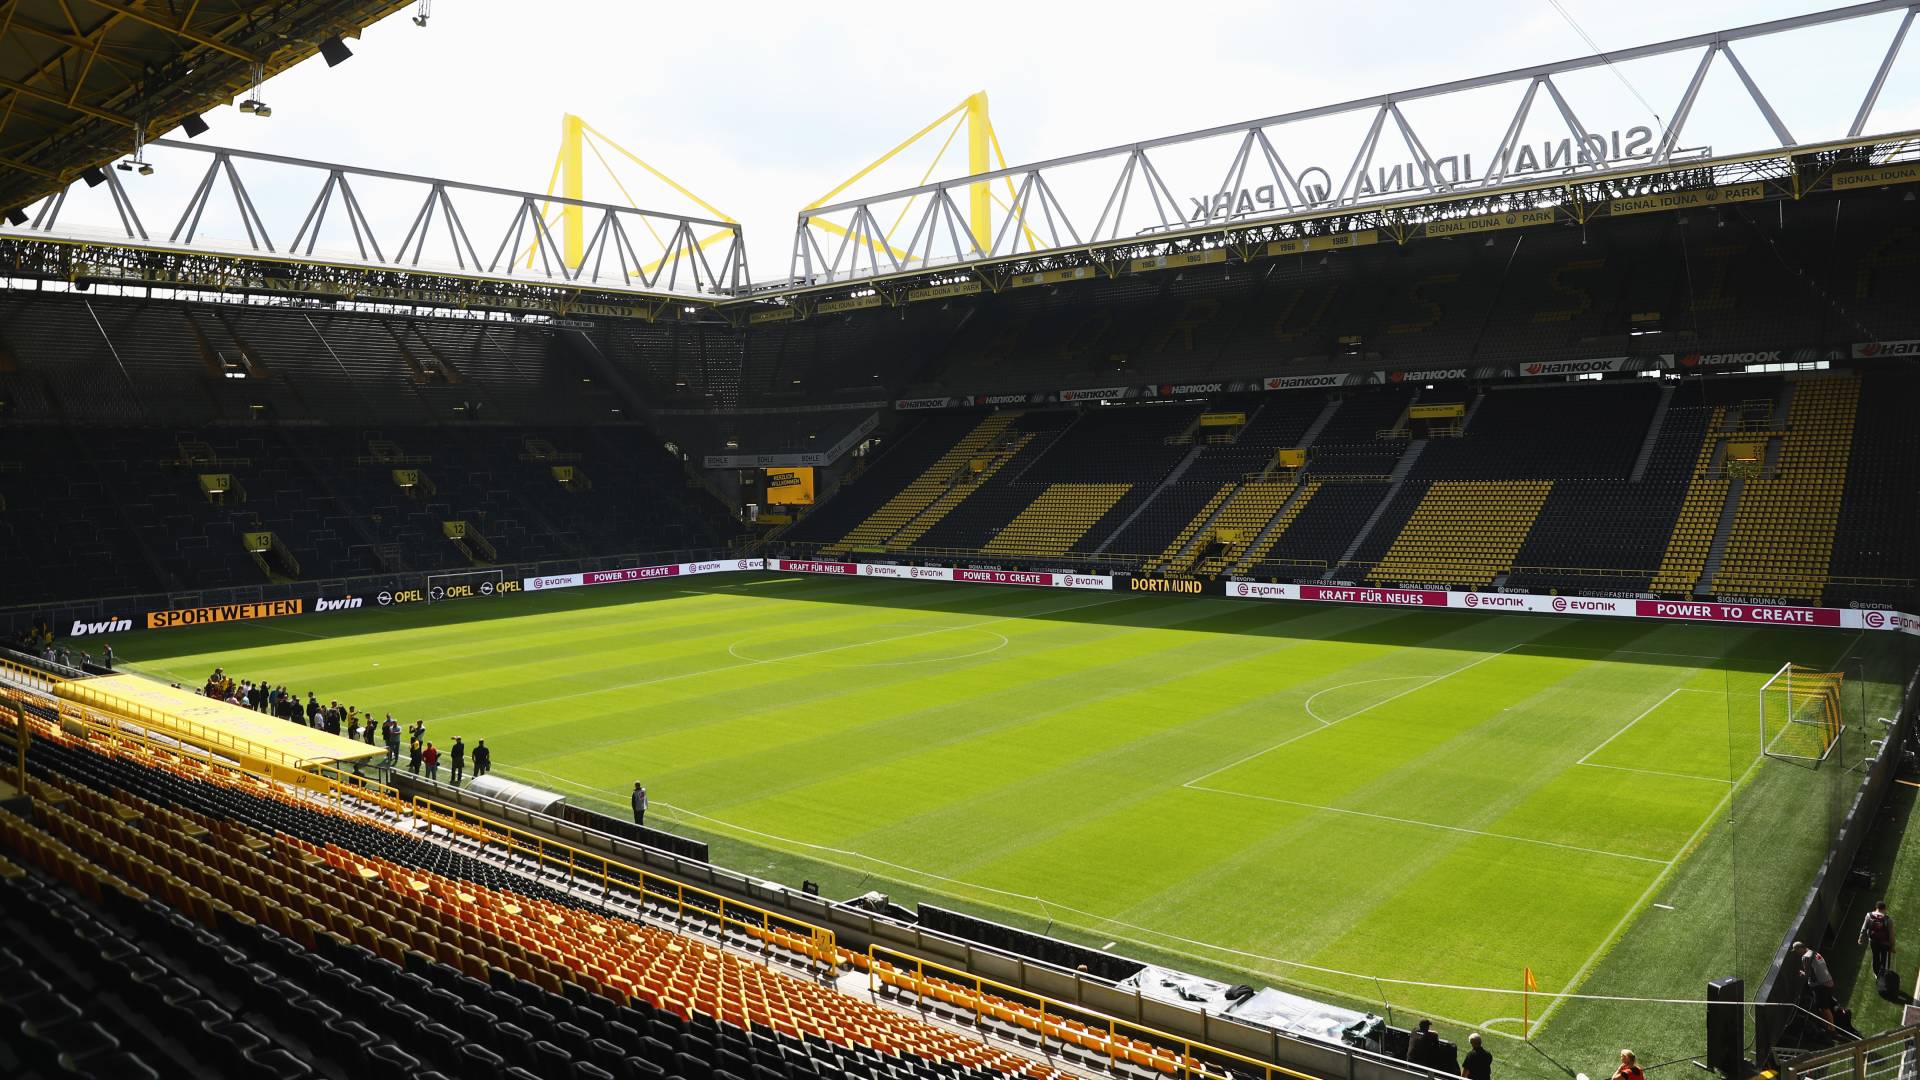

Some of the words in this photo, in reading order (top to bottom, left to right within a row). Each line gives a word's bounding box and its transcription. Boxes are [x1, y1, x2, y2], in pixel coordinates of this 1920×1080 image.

[1837, 174, 1877, 185] SIGNAL
[1881, 169, 1917, 180] IDUNA
[1613, 199, 1656, 212] SIGNAL
[1660, 194, 1698, 207] IDUNA
[1725, 186, 1760, 199] PARK
[1429, 221, 1465, 234] SIGNAL
[1468, 217, 1500, 229] IDUNA
[1522, 210, 1552, 222] PARK
[932, 287, 951, 296] IDUNA
[963, 284, 980, 294] PARK
[1699, 350, 1780, 365] HANKOOK
[1541, 358, 1612, 374] HANKOOK
[1404, 368, 1467, 381] HANKOOK
[1281, 375, 1337, 388] HANKOOK
[1075, 388, 1119, 400] HANKOOK
[1171, 383, 1222, 394] HANKOOK
[216, 477, 227, 488] 13
[407, 472, 416, 482] 12
[454, 524, 463, 534] 12
[257, 535, 269, 547] 13
[698, 562, 721, 572] EVONIK
[789, 562, 810, 571] KRAFT
[812, 562, 823, 573] FÜR
[824, 564, 845, 573] NEUES
[874, 567, 897, 575] EVONIK
[920, 568, 943, 577] EVONIK
[594, 571, 624, 582] POWER
[627, 569, 638, 580] TO
[640, 566, 669, 579] CREATE
[963, 570, 993, 581] POWER
[995, 573, 1006, 582] TO
[1010, 573, 1041, 583] CREATE
[496, 581, 522, 593] OPEL
[545, 577, 572, 587] EVONIK
[1075, 576, 1104, 586] EVONIK
[395, 589, 423, 603] OPEL
[447, 585, 474, 599] OPEL
[1250, 585, 1285, 596] EVONIK
[1319, 589, 1357, 601] KRAFT
[1360, 588, 1383, 602] FÜR
[1386, 593, 1424, 605] NEUES
[315, 594, 363, 612] bwin
[1482, 597, 1524, 607] EVONIK
[1571, 601, 1616, 612] EVONIK
[1717, 596, 1748, 604] SIGNAL
[1750, 597, 1776, 605] IDUNA
[153, 599, 298, 627] SPORTWETTEN
[1657, 603, 1712, 618] POWER
[1720, 606, 1743, 620] TO
[1752, 607, 1815, 623] CREATE
[71, 616, 132, 636] bwin
[296, 775, 307, 784] 42
